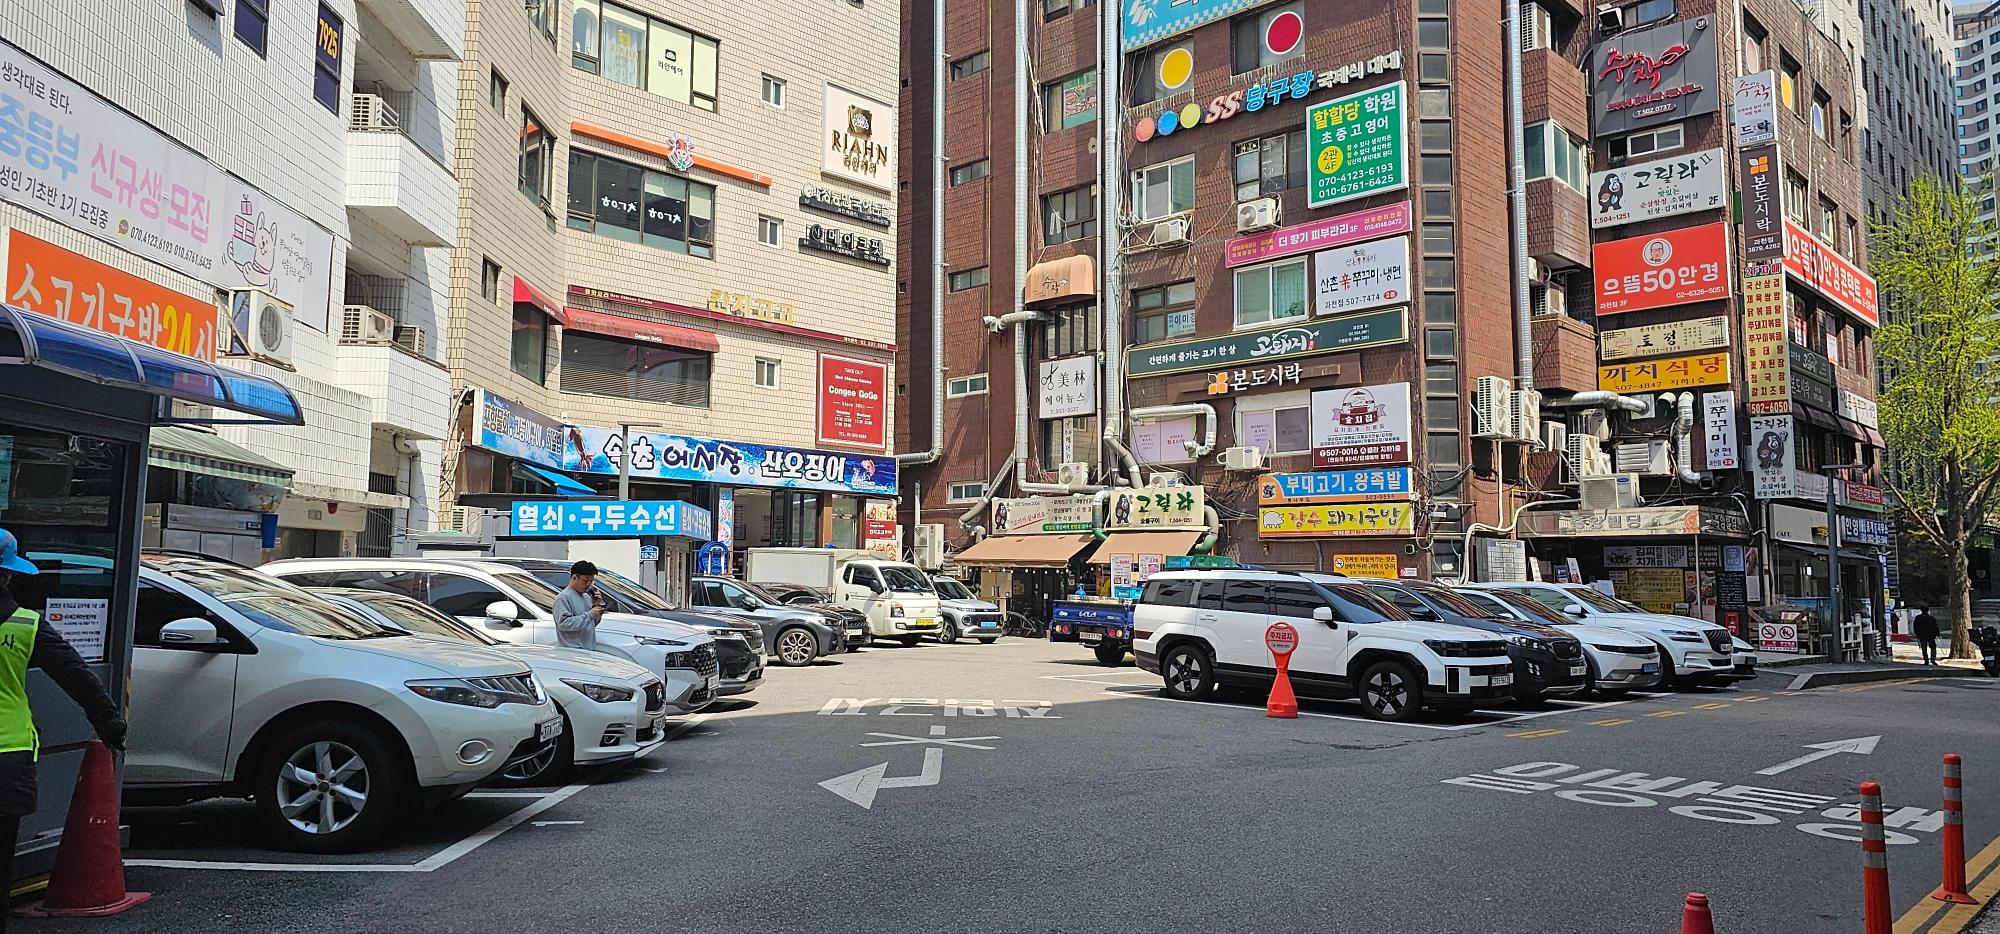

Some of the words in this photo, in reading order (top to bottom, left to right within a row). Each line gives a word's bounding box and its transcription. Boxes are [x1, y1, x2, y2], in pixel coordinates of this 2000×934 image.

[318, 19, 339, 60] 7925
[657, 60, 684, 76] 리안헤어
[1, 60, 46, 100] 생각대로
[48, 86, 73, 115] 된다.
[1204, 90, 1244, 124] SS
[1246, 70, 1315, 112] 당구장
[1316, 61, 1365, 90] 국제식
[1366, 50, 1401, 74] 대대
[1313, 101, 1360, 130] 할할당
[1364, 90, 1396, 114] 학원
[1321, 131, 1333, 144] 초
[1336, 127, 1347, 141] 중
[1350, 124, 1362, 137] 고
[1365, 115, 1388, 134] 영어
[832, 130, 888, 166] RIAHN
[1323, 149, 1338, 160] 2관
[0, 92, 81, 182] 중등부
[91, 142, 163, 220] 신규생
[167, 182, 211, 244] 모집
[1318, 163, 1394, 188] 070-4123-6193
[1324, 161, 1337, 171] 4F
[1633, 159, 1700, 189] 고릴라
[1318, 174, 1394, 198] 010-6761-6425
[0, 165, 22, 192] 성인
[25, 177, 58, 208] 기초반
[61, 193, 78, 217] 1기
[78, 204, 110, 230] 모집중
[1708, 195, 1719, 206] 2F
[1751, 174, 1773, 233] 본도시락
[1593, 213, 1630, 225] T.504-1251
[1278, 237, 1288, 248] 더
[1290, 232, 1309, 246] 향기
[1311, 223, 1349, 240] 피부관리
[1603, 261, 1719, 296] 으뜸50안경
[1744, 266, 1760, 278] 2F
[1760, 263, 1780, 275] 자매
[1321, 275, 1339, 294] 산촌
[1676, 286, 1725, 299] 02-6326-5051
[1324, 299, 1344, 309] 과천점
[1345, 293, 1380, 306] 507-7474
[1619, 299, 1628, 307] 3F
[1149, 354, 1176, 365] 간편하게
[1201, 348, 1217, 359] 고기
[1229, 345, 1237, 355] 상
[1057, 370, 1086, 388] 美林
[1229, 362, 1304, 392] 본도시락
[1603, 356, 1725, 383] 까치식당
[828, 385, 857, 397] Congee
[858, 390, 878, 400] GoGo
[1615, 381, 1662, 391] 507-4847
[1045, 392, 1086, 406] 헤어뉴스
[1751, 402, 1789, 414] 502-6050
[1709, 405, 1729, 446] 쭈꾸미
[1753, 417, 1789, 430] 고릴라
[602, 433, 656, 470] 속초
[662, 442, 744, 477] 어시장
[761, 449, 848, 483] 산오징어
[1326, 448, 1359, 457] 507-0016
[1709, 447, 1732, 457] 냉면
[1136, 490, 1195, 513] 고릴라
[518, 504, 675, 532] 열쇠·구두수선
[1288, 510, 1323, 529] 장수
[1327, 507, 1402, 528] 돼지국밥
[1270, 631, 1292, 640] 주차금지
[815, 697, 1063, 719] 진입금지
[1440, 760, 1946, 845] 일방통행
